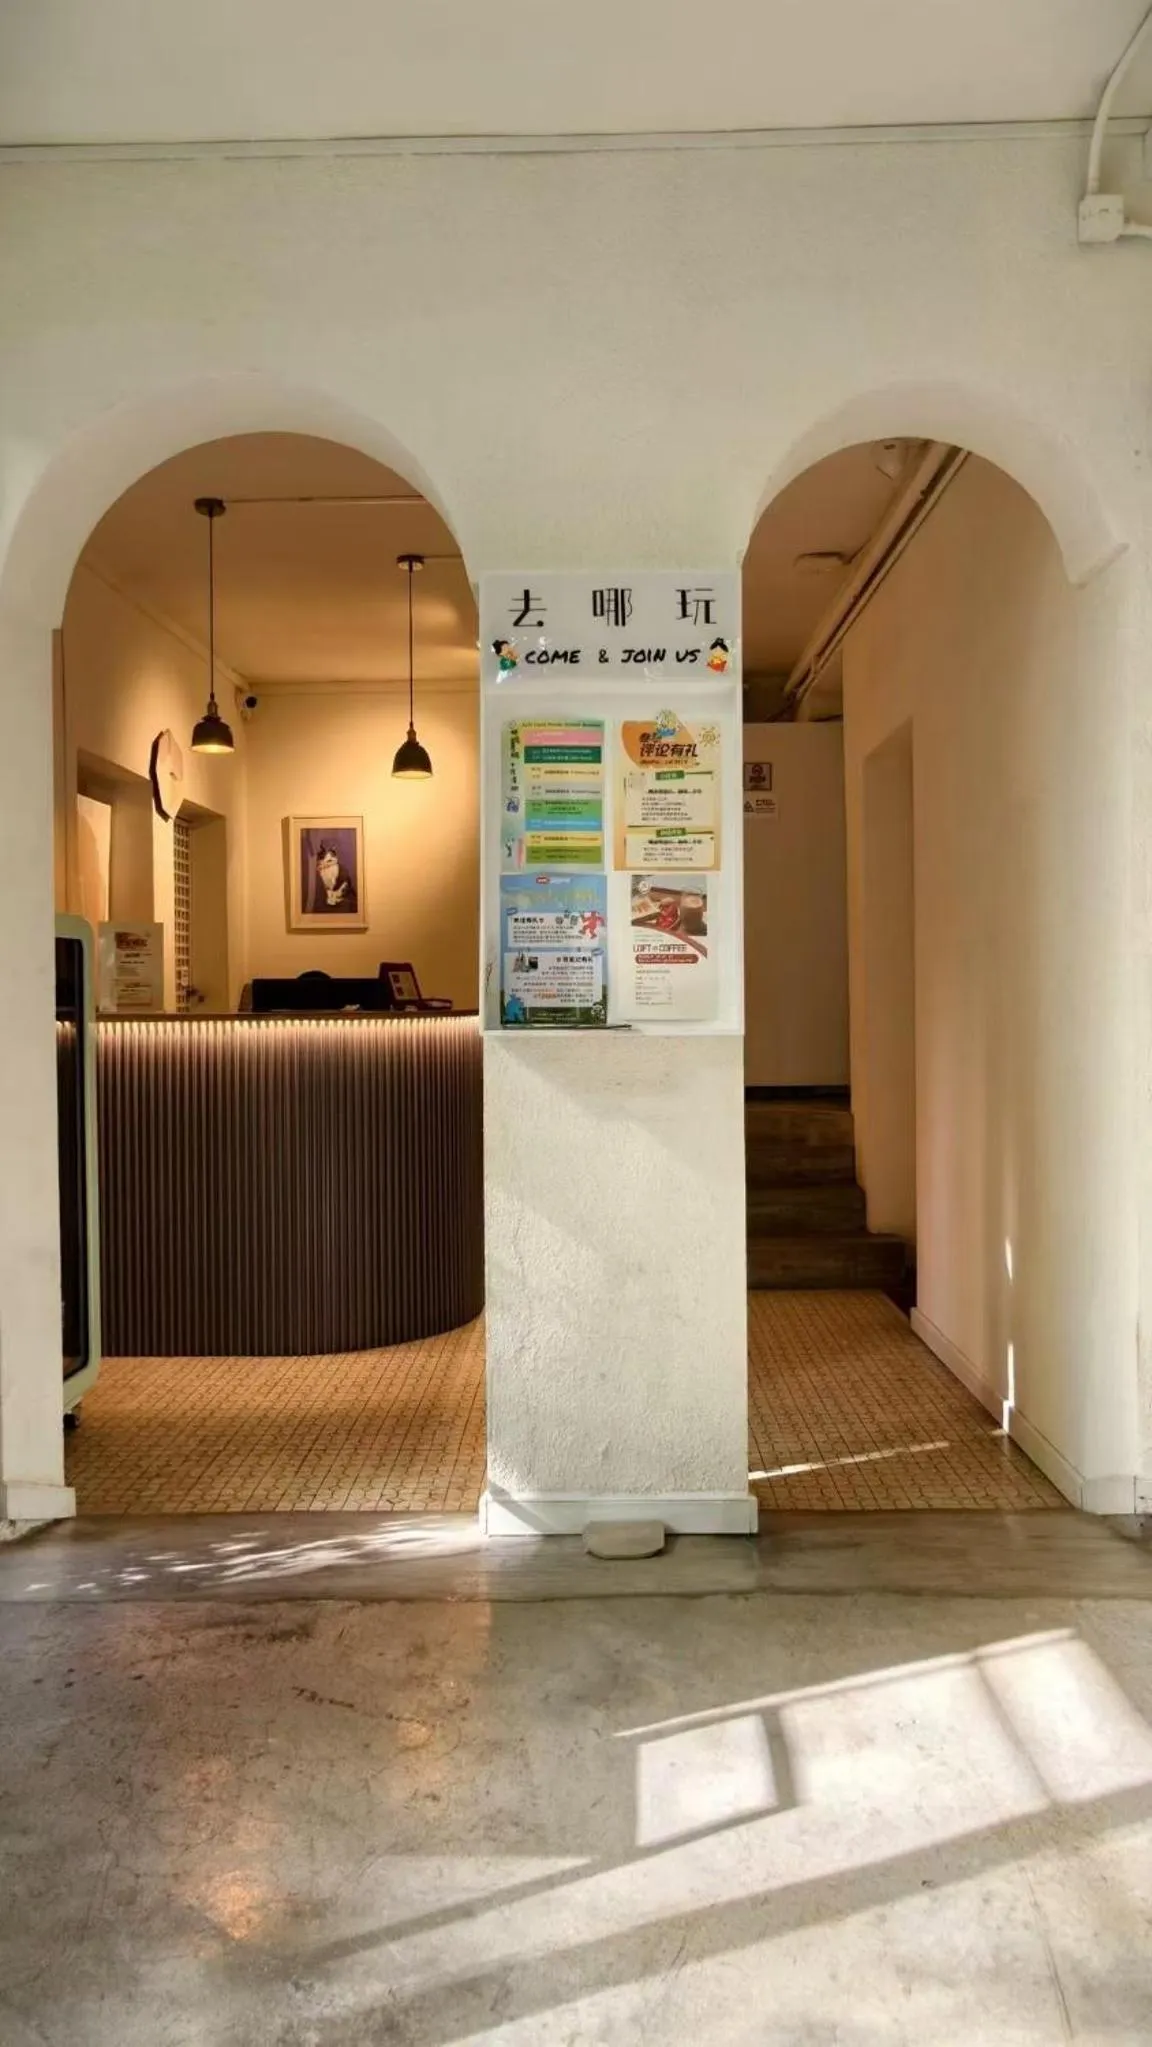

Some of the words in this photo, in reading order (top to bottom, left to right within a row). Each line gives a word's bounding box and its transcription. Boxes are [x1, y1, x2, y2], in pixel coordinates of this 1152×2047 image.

[508, 587, 717, 627] 去哪玩
[525, 649, 581, 664] COME
[598, 648, 609, 664] &
[621, 648, 666, 664] JOIN
[676, 648, 701, 664] US
